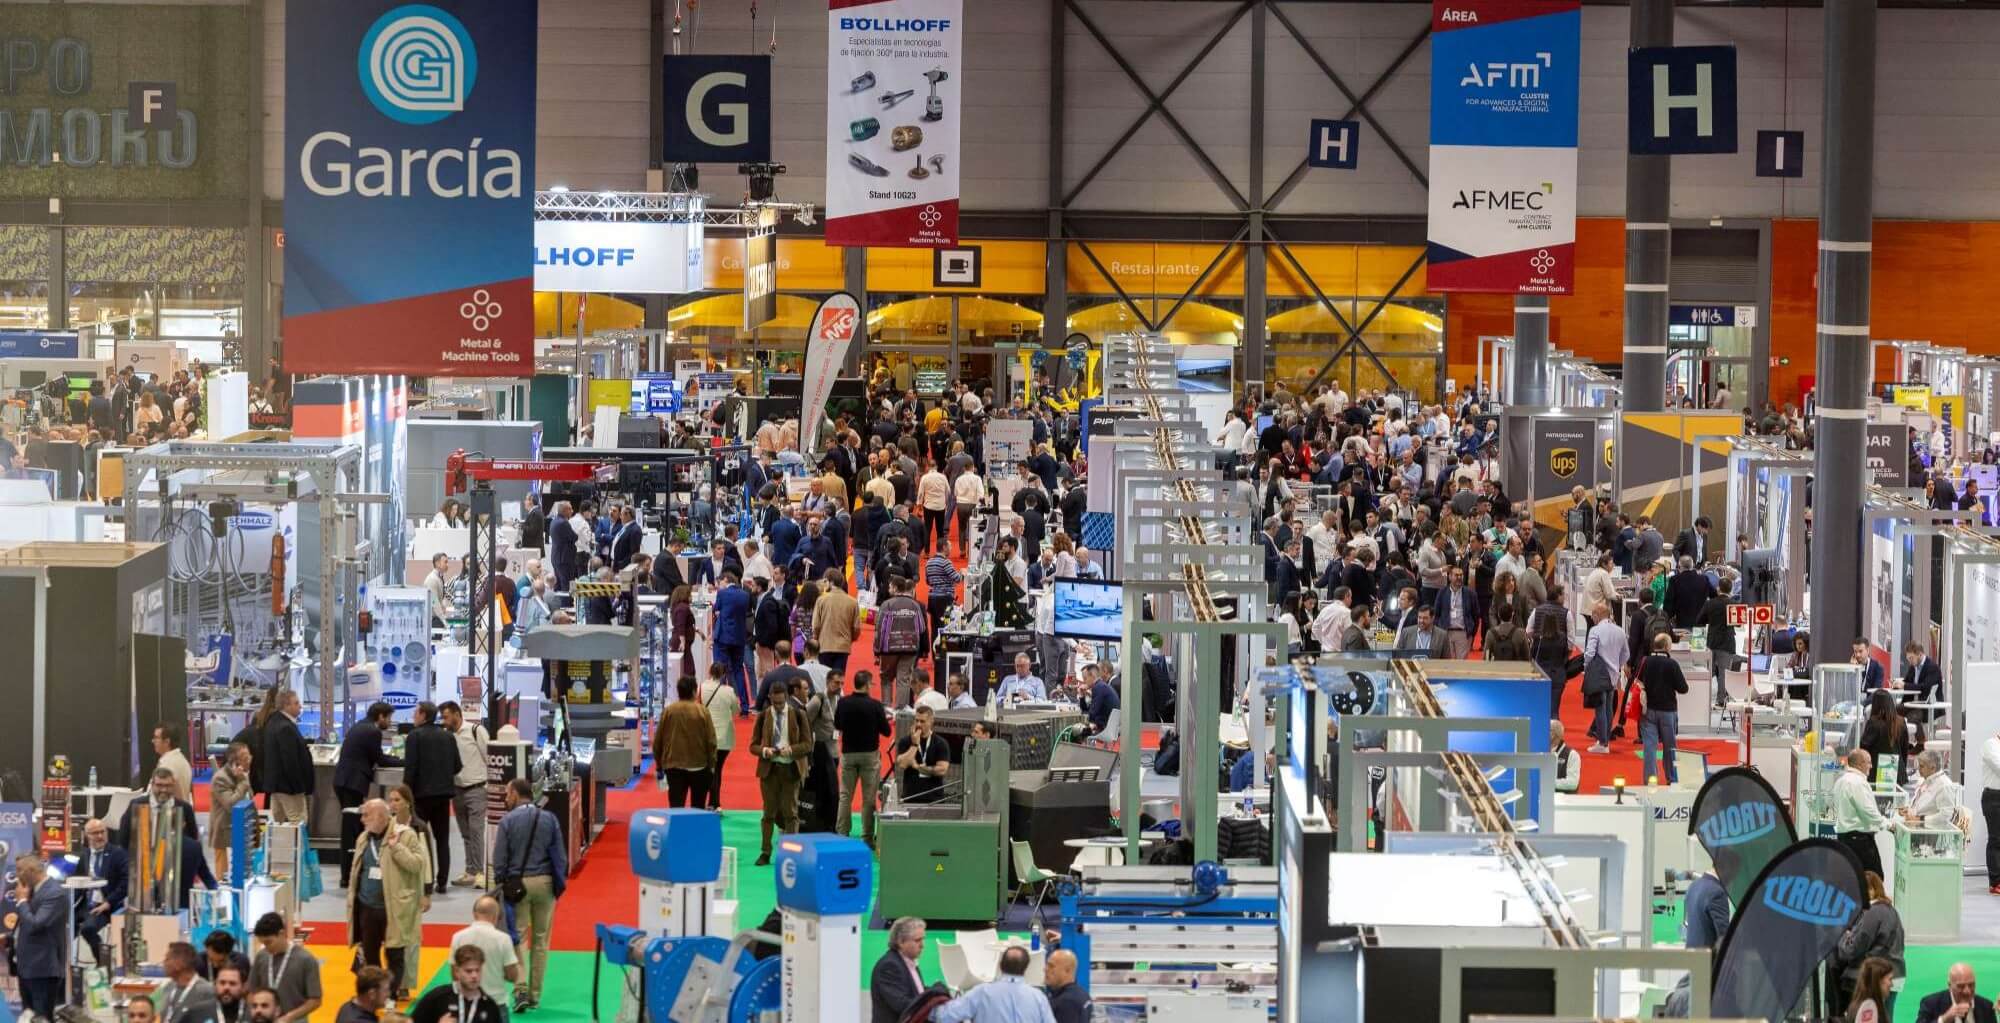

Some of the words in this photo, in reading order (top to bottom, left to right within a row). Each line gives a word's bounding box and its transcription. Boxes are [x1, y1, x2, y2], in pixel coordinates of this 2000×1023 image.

[840, 17, 951, 31] BÖLLHOFF
[1441, 8, 1478, 22] ÁREA
[894, 49, 911, 58] para
[3, 36, 92, 95] PO
[143, 89, 162, 123] F
[685, 72, 749, 146] G
[1653, 63, 1713, 138] H
[1320, 127, 1348, 161] H
[1775, 136, 1785, 170] I
[300, 131, 522, 198] García
[869, 190, 891, 200] Stand
[1452, 189, 1544, 210] AFMEC
[1111, 261, 1200, 275] Restaurante
[1519, 285, 1547, 293] Machine
[460, 338, 491, 348] Metal
[493, 338, 501, 348] &
[442, 351, 488, 361] Machine
[490, 351, 520, 361] Tools
[1941, 402, 1951, 456] LOMAR
[1553, 457, 1576, 474] ups
[1763, 875, 1858, 924] TYROLIT
[1253, 1000, 1261, 1008] 2
